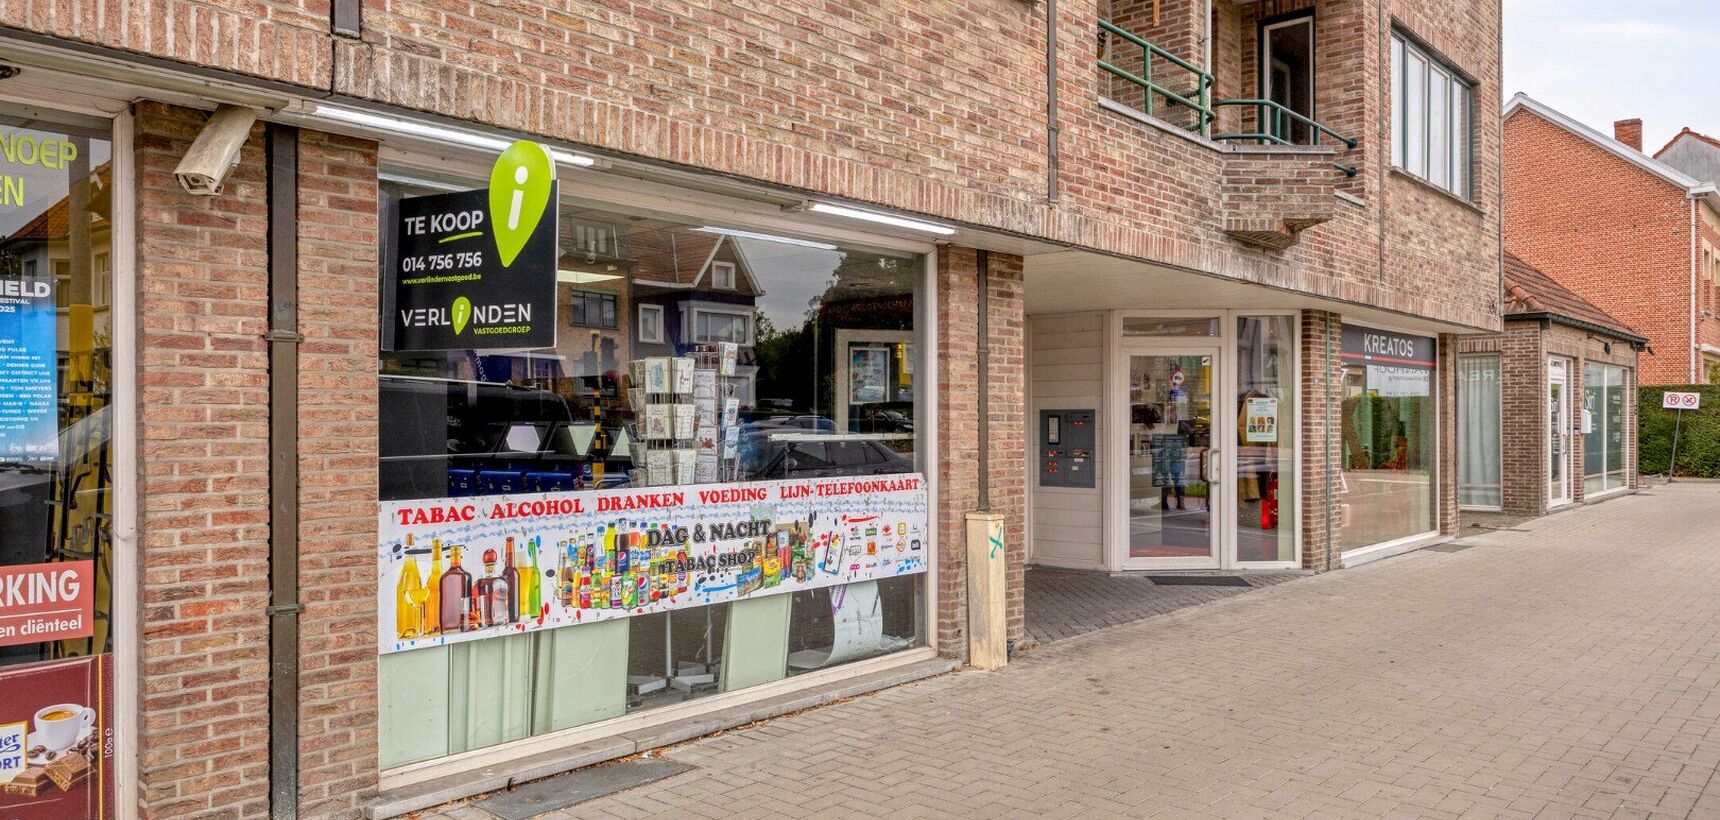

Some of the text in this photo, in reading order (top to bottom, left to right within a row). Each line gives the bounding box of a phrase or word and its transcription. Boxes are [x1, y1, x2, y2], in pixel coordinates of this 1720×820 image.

[404, 210, 484, 235] TE KOOP
[402, 251, 483, 272] 014 756 756
[402, 273, 482, 285] www.verlindenvastgoed.be
[473, 325, 532, 335] VASTGOEDGROEP
[1363, 333, 1414, 358] KREATOS
[397, 504, 476, 526] TABAC
[489, 498, 585, 520] ALCOHOL
[596, 492, 685, 513] DRANKEN
[699, 487, 768, 505] VOEDING
[647, 519, 772, 547] DAG & NACHT
[717, 551, 755, 568] SHOP
[20, 613, 83, 636] cliënteel
